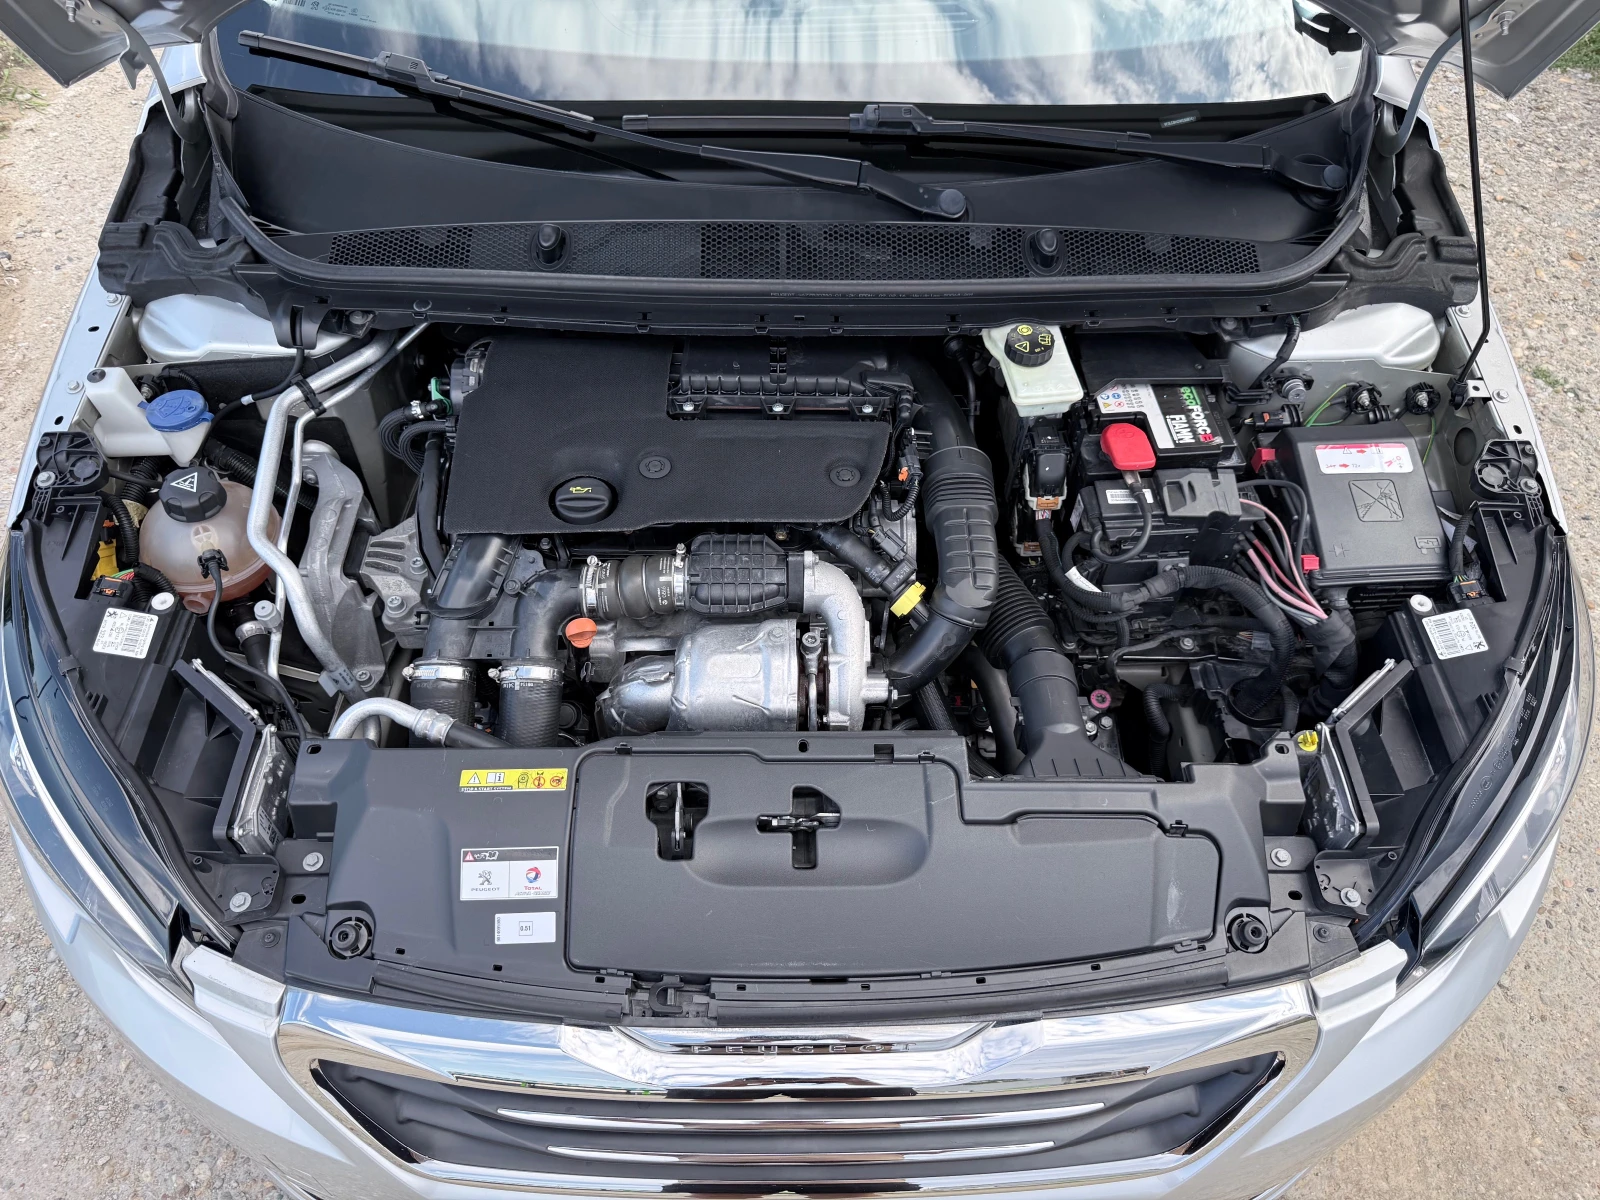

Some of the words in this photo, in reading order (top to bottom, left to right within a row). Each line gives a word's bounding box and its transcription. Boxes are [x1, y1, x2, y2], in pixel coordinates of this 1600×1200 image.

[1168, 414, 1196, 444] FIAMM
[1180, 386, 1215, 443] ecoFORCE
[691, 1042, 917, 1054] PEUGEOT
